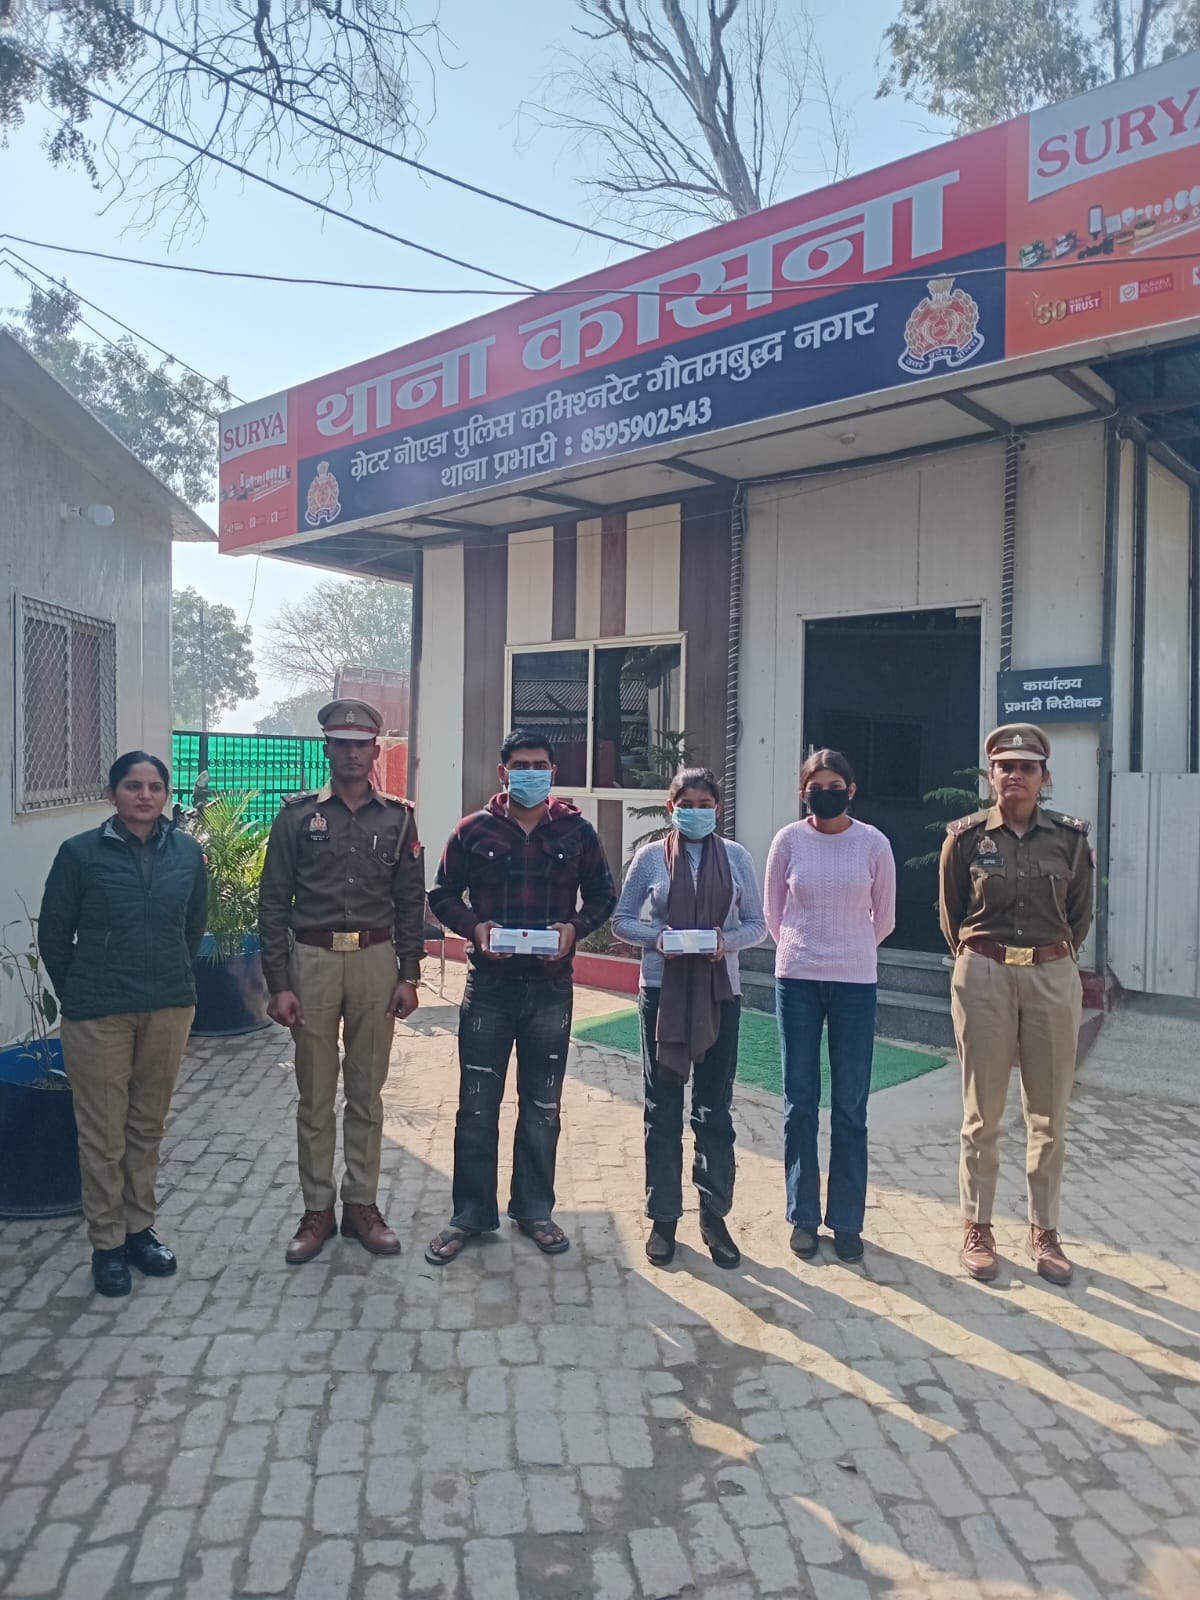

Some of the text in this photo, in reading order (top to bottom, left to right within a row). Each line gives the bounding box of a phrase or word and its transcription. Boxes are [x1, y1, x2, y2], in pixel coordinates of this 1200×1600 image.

[1037, 88, 1200, 177] SURY
[316, 169, 961, 438] थाना कासना
[1069, 298, 1100, 313] TRUST
[351, 303, 879, 481] ग्रेटर नोएडा पुलिस कमिश्नरेट गौतमबुद्ध नगर
[223, 412, 284, 452] SURYA
[441, 456, 487, 488] थाना
[494, 432, 558, 481] प्रभारी
[581, 397, 712, 452] 8595902543
[1004, 695, 1103, 714] प्रभारी निरीक्षक
[1023, 676, 1082, 691] कार्यालय
